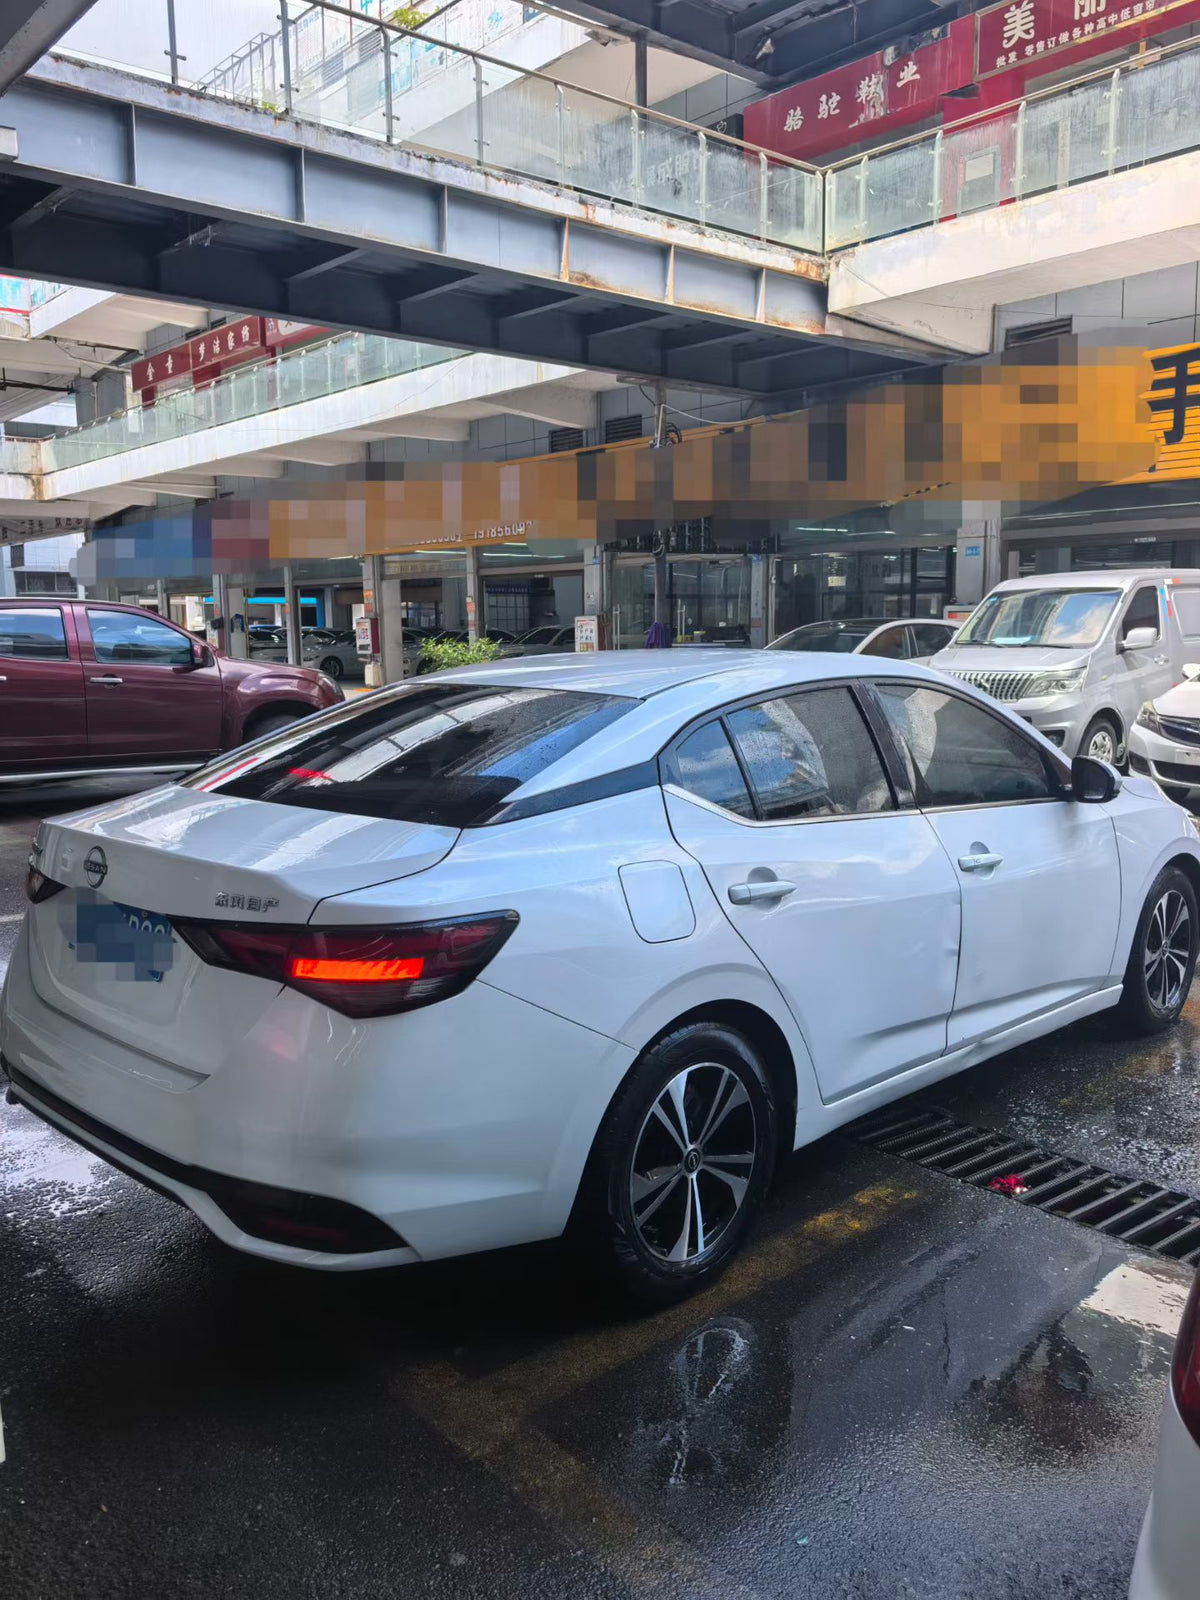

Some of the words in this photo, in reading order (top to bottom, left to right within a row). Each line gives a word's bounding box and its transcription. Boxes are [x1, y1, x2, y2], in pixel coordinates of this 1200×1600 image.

[995, 51, 1018, 68] 批发
[215, 892, 280, 913] 东风日产
